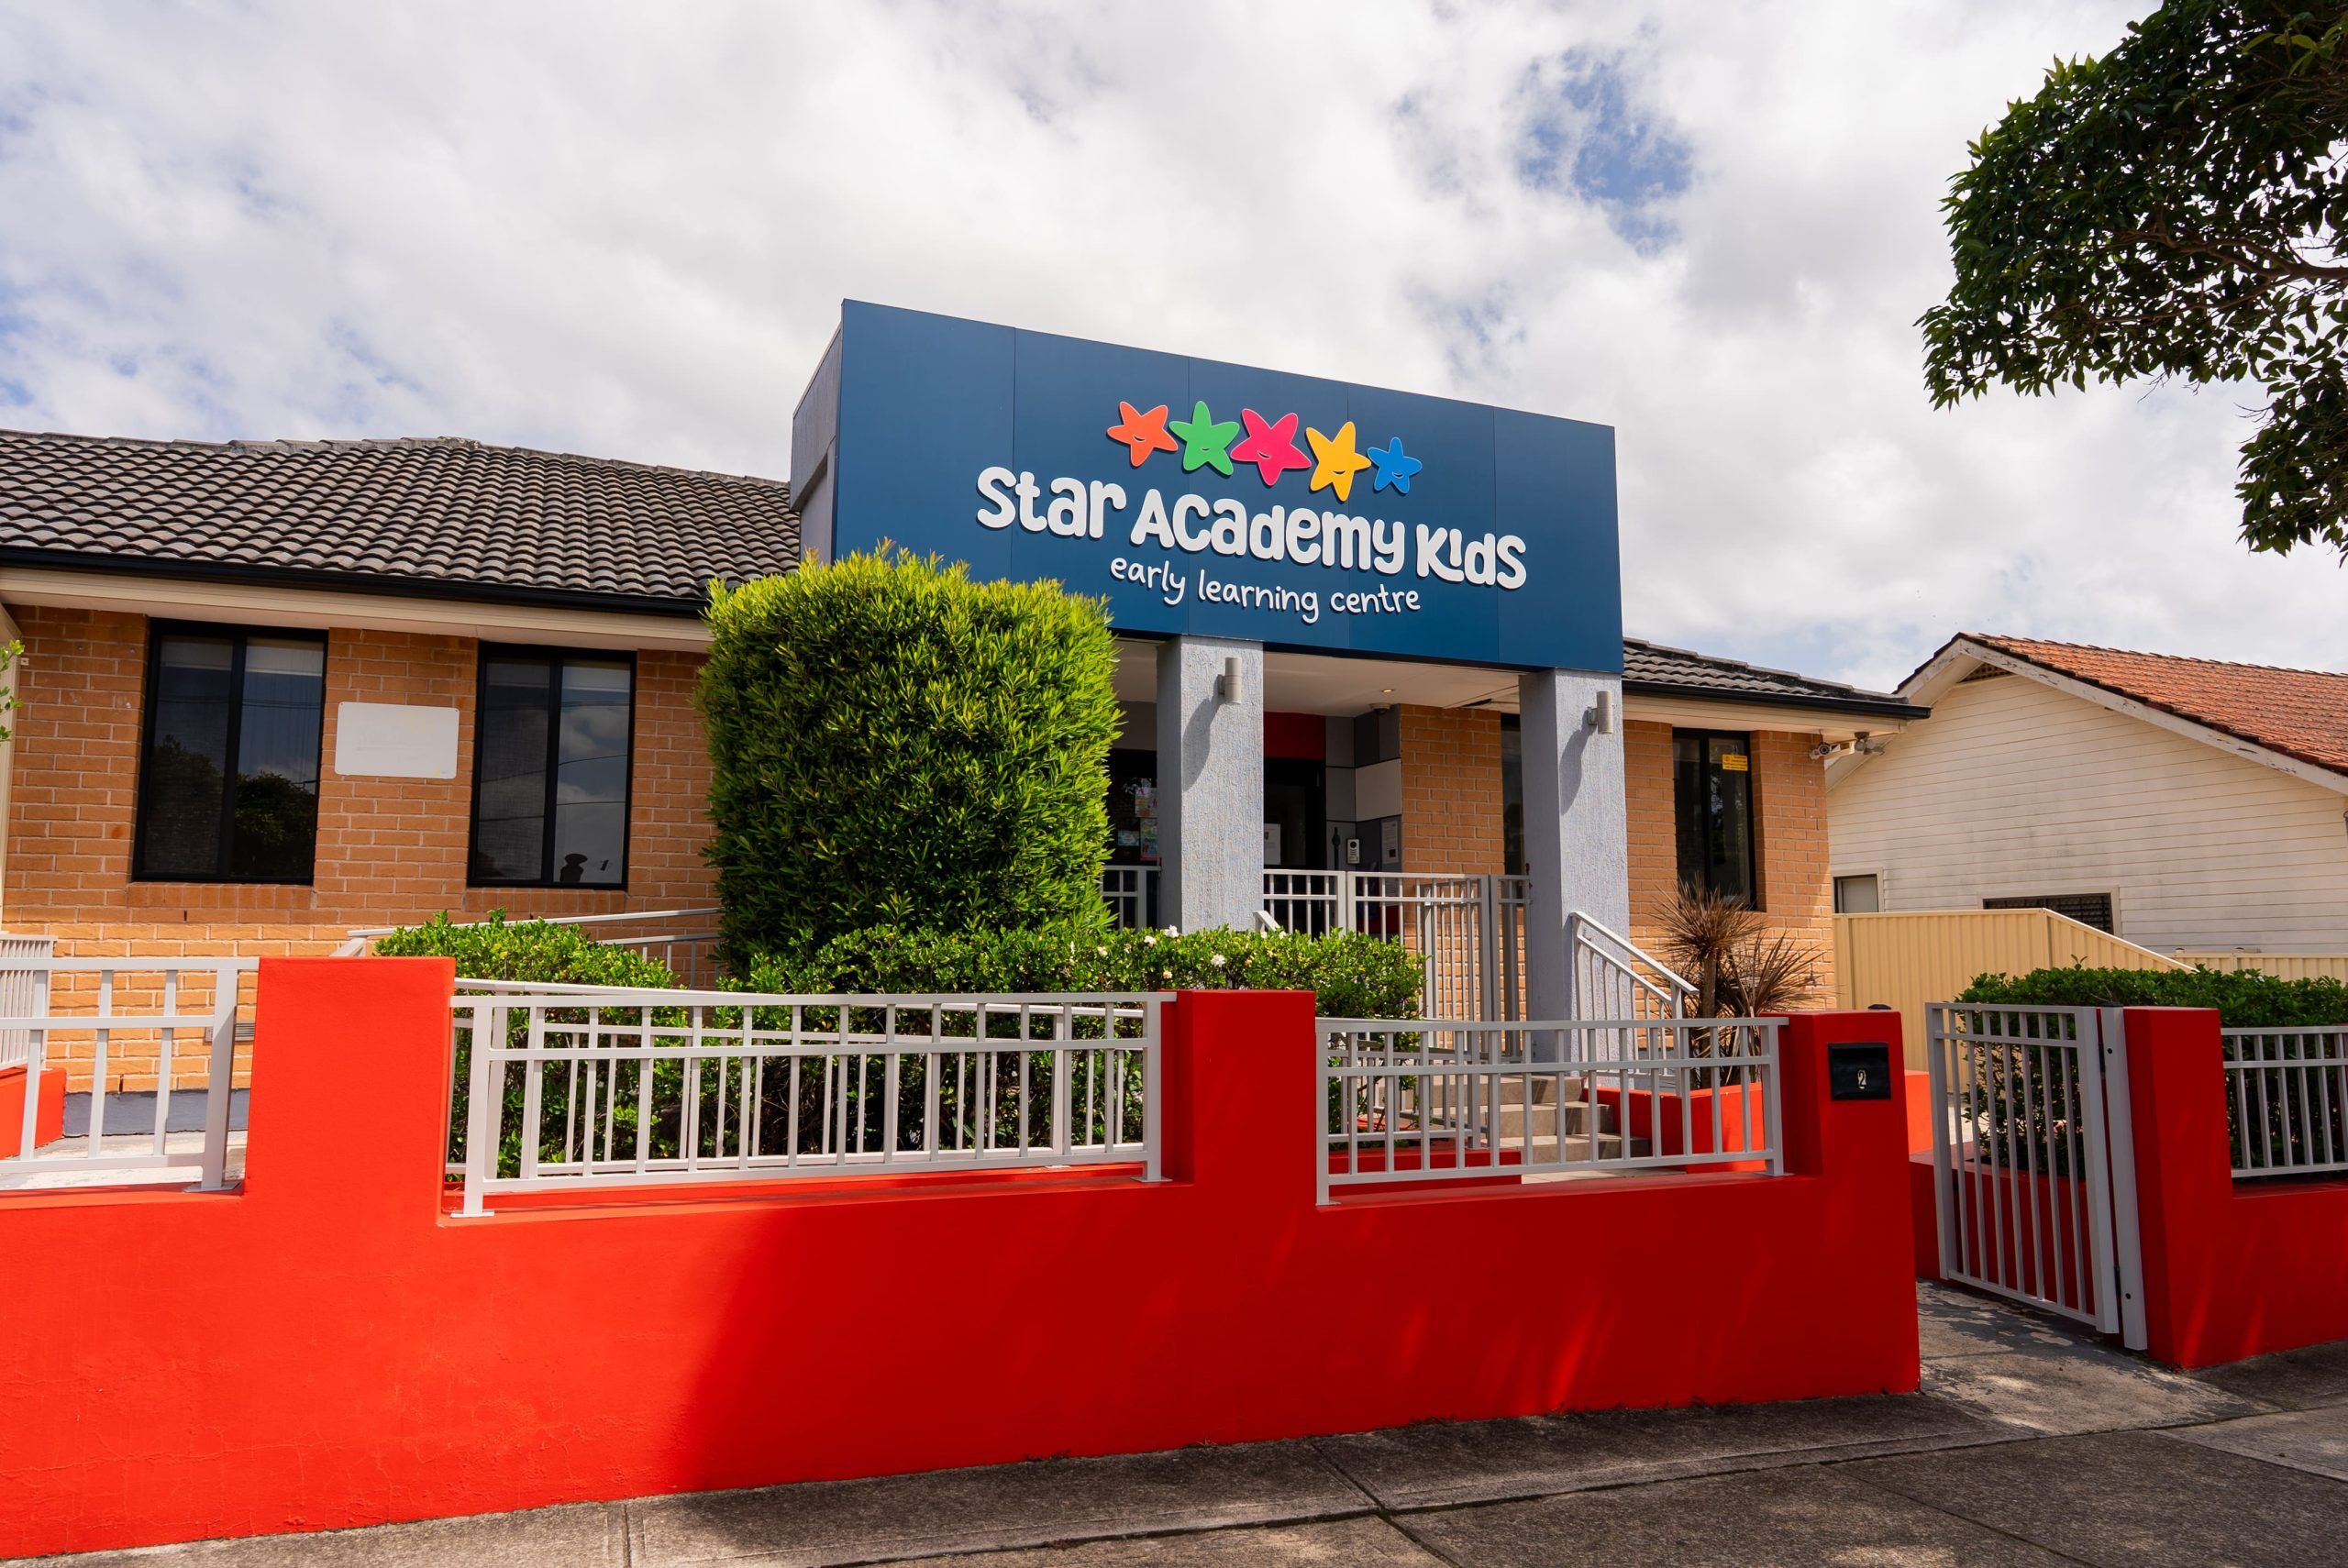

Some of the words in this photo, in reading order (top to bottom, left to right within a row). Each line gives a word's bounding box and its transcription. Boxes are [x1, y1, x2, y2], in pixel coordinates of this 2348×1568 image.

[978, 467, 1127, 538] Star
[1130, 489, 1406, 574] Academy
[1416, 524, 1527, 590] Kids
[1111, 557, 1185, 605] early
[1199, 569, 1319, 624] learning
[1330, 583, 1421, 613] centre
[1857, 1069, 1867, 1089] 2
